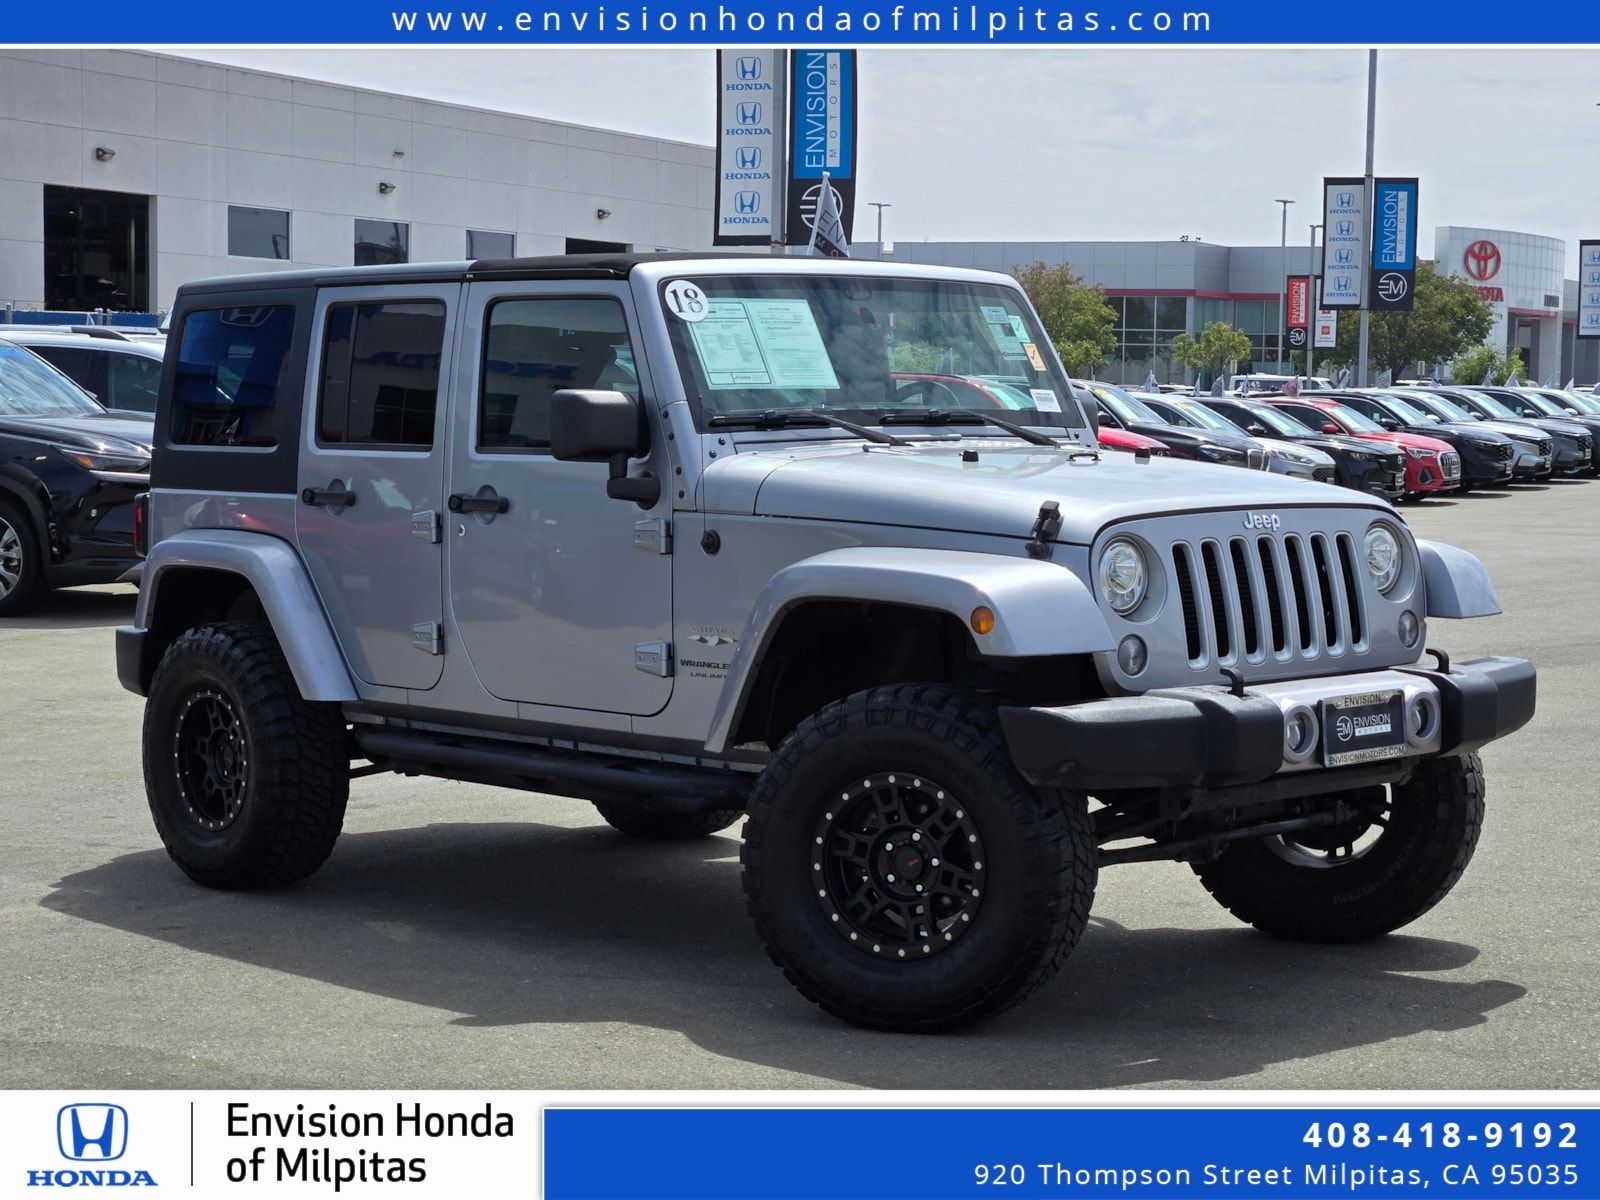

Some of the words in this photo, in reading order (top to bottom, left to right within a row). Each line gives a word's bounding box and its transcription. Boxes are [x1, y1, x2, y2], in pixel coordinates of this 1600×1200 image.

[725, 82, 772, 91] HONDA
[805, 52, 825, 168] ENVISION
[829, 63, 838, 158] MOTORS
[725, 127, 772, 136] HONDA
[725, 172, 771, 180] HONDA
[723, 216, 769, 224] HONDA
[1382, 190, 1397, 263] ENVISION
[668, 288, 704, 313] 18
[1291, 282, 1301, 324] ENVISION
[1243, 512, 1281, 532] Jeep
[690, 625, 736, 635] SAHARA
[680, 659, 731, 670] WRANGLE
[1344, 694, 1381, 707] ENVISION
[1353, 713, 1391, 728] ENVISION
[1329, 745, 1405, 765] ENVISIONMOTORS.COM
